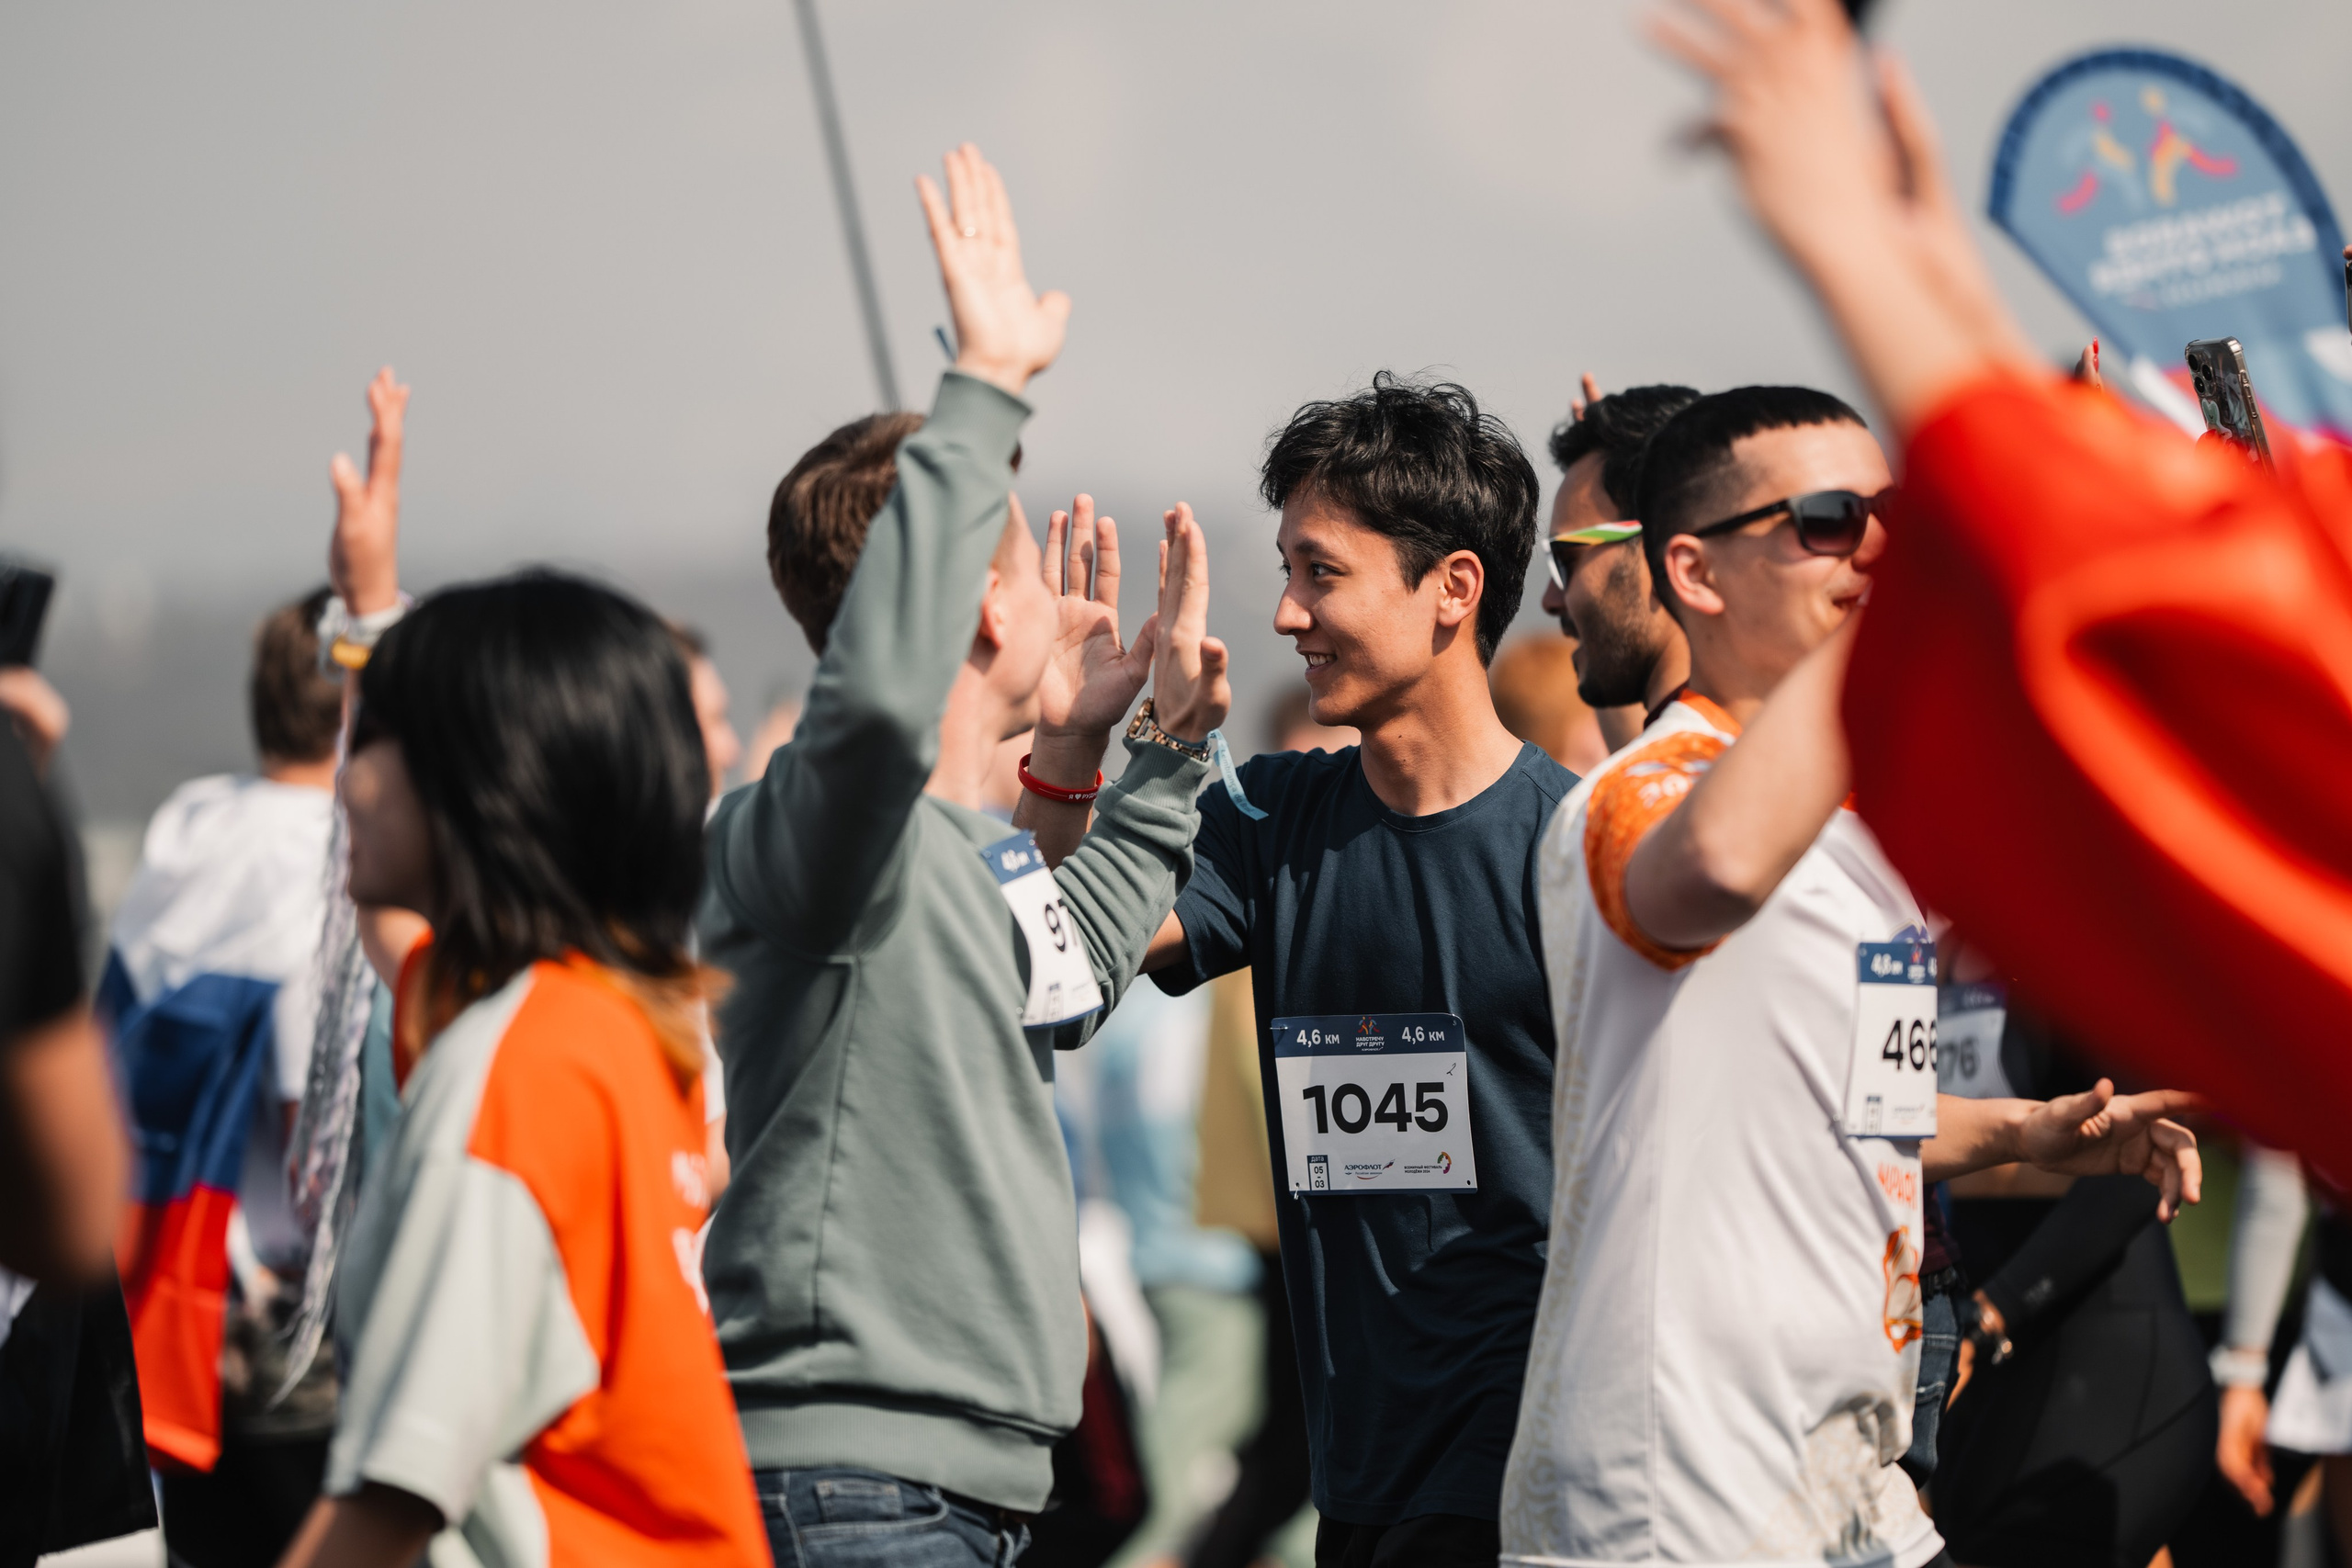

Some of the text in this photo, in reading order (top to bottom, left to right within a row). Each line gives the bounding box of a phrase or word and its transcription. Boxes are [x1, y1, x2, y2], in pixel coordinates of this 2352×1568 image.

[1296, 1029, 1321, 1048] 4,6
[1401, 1026, 1425, 1045] 4,6
[1302, 1081, 1449, 1134] 1045
[1314, 1166, 1324, 1175] 05
[1315, 1179, 1325, 1189] 03
